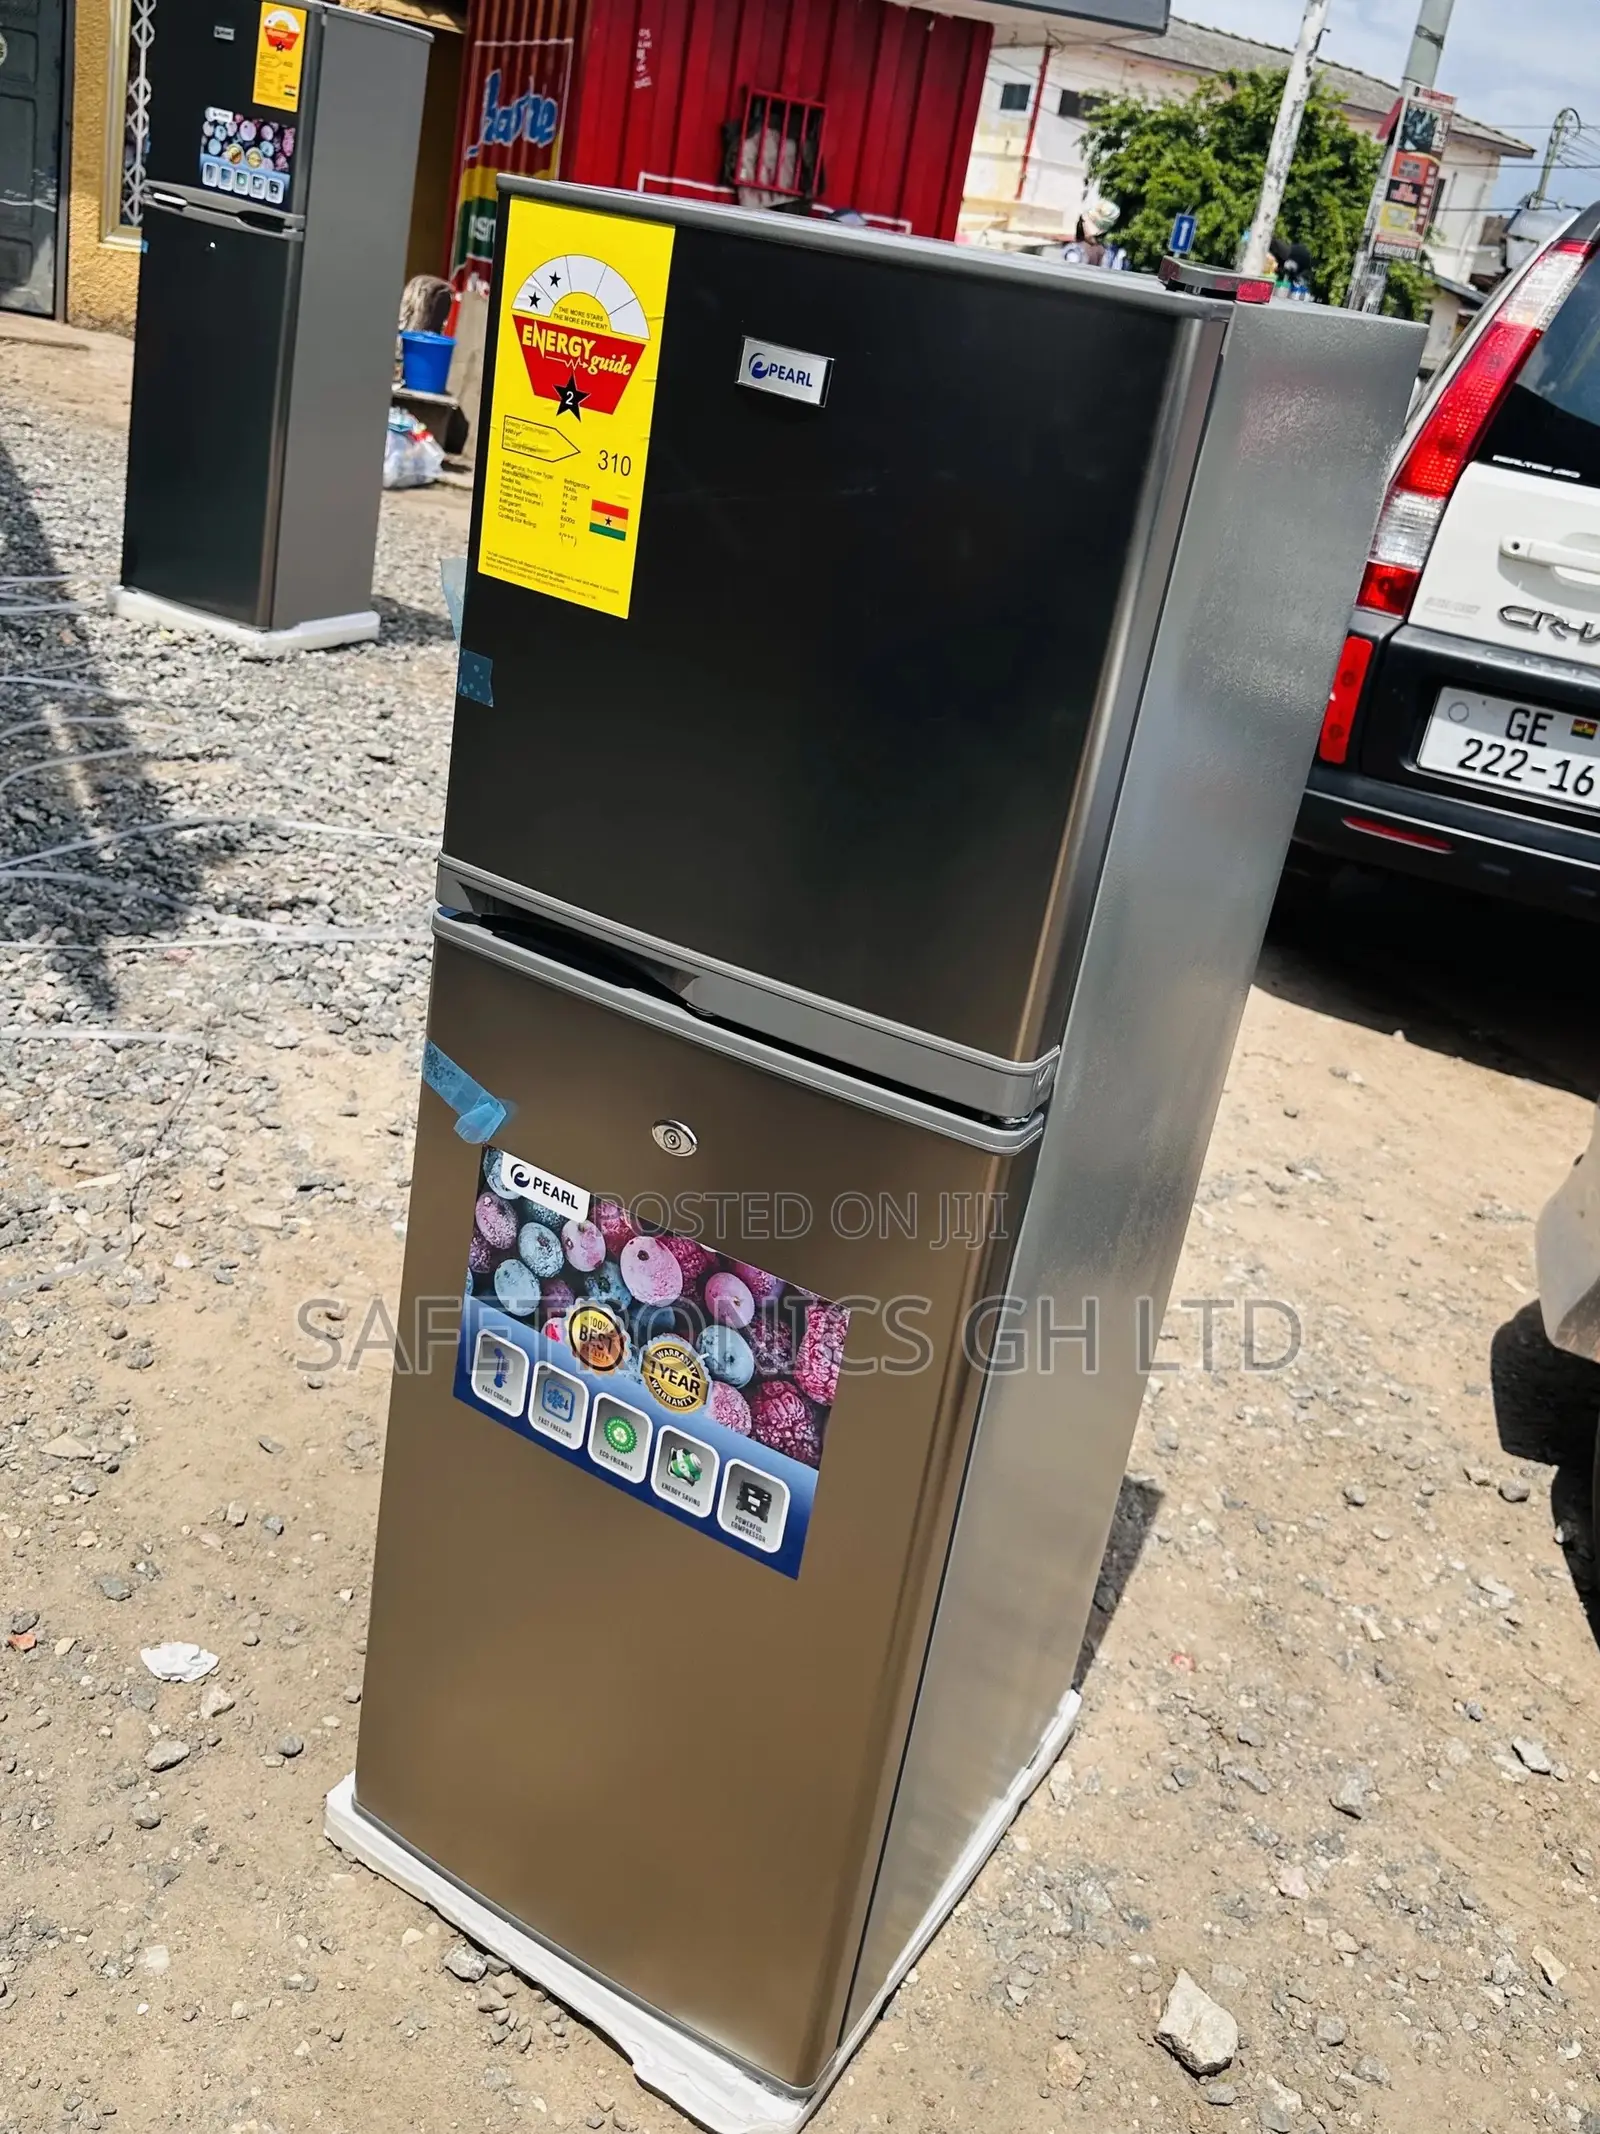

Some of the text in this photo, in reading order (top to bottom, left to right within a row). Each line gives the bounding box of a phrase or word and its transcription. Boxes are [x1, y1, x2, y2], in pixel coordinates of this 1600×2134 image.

[553, 313, 608, 331] THE MORE EFFICIENT
[558, 306, 604, 322] THE MORE STARS
[522, 321, 596, 360] ENERGY
[587, 354, 632, 376] guide
[768, 362, 813, 388] PEARL
[565, 390, 574, 406] 2
[597, 449, 632, 477] 310
[1505, 707, 1554, 748] GE
[1457, 737, 1595, 797] 222-16
[533, 1176, 579, 1210] PEARL
[590, 1317, 609, 1332] 100%
[579, 1324, 613, 1355] BEST
[656, 1349, 698, 1376] WARRANTY
[649, 1360, 701, 1396] 1 YEAR
[481, 1384, 512, 1406] FAST COOLING
[651, 1379, 693, 1406] WARRANTY
[538, 1416, 572, 1439] FAST FREEZING
[599, 1449, 633, 1472] ECO-FRIENDLY
[661, 1482, 701, 1507] ENERGY SAVING
[730, 1521, 766, 1543] COMPRESSOR
[734, 1514, 762, 1534] POWERFUL
